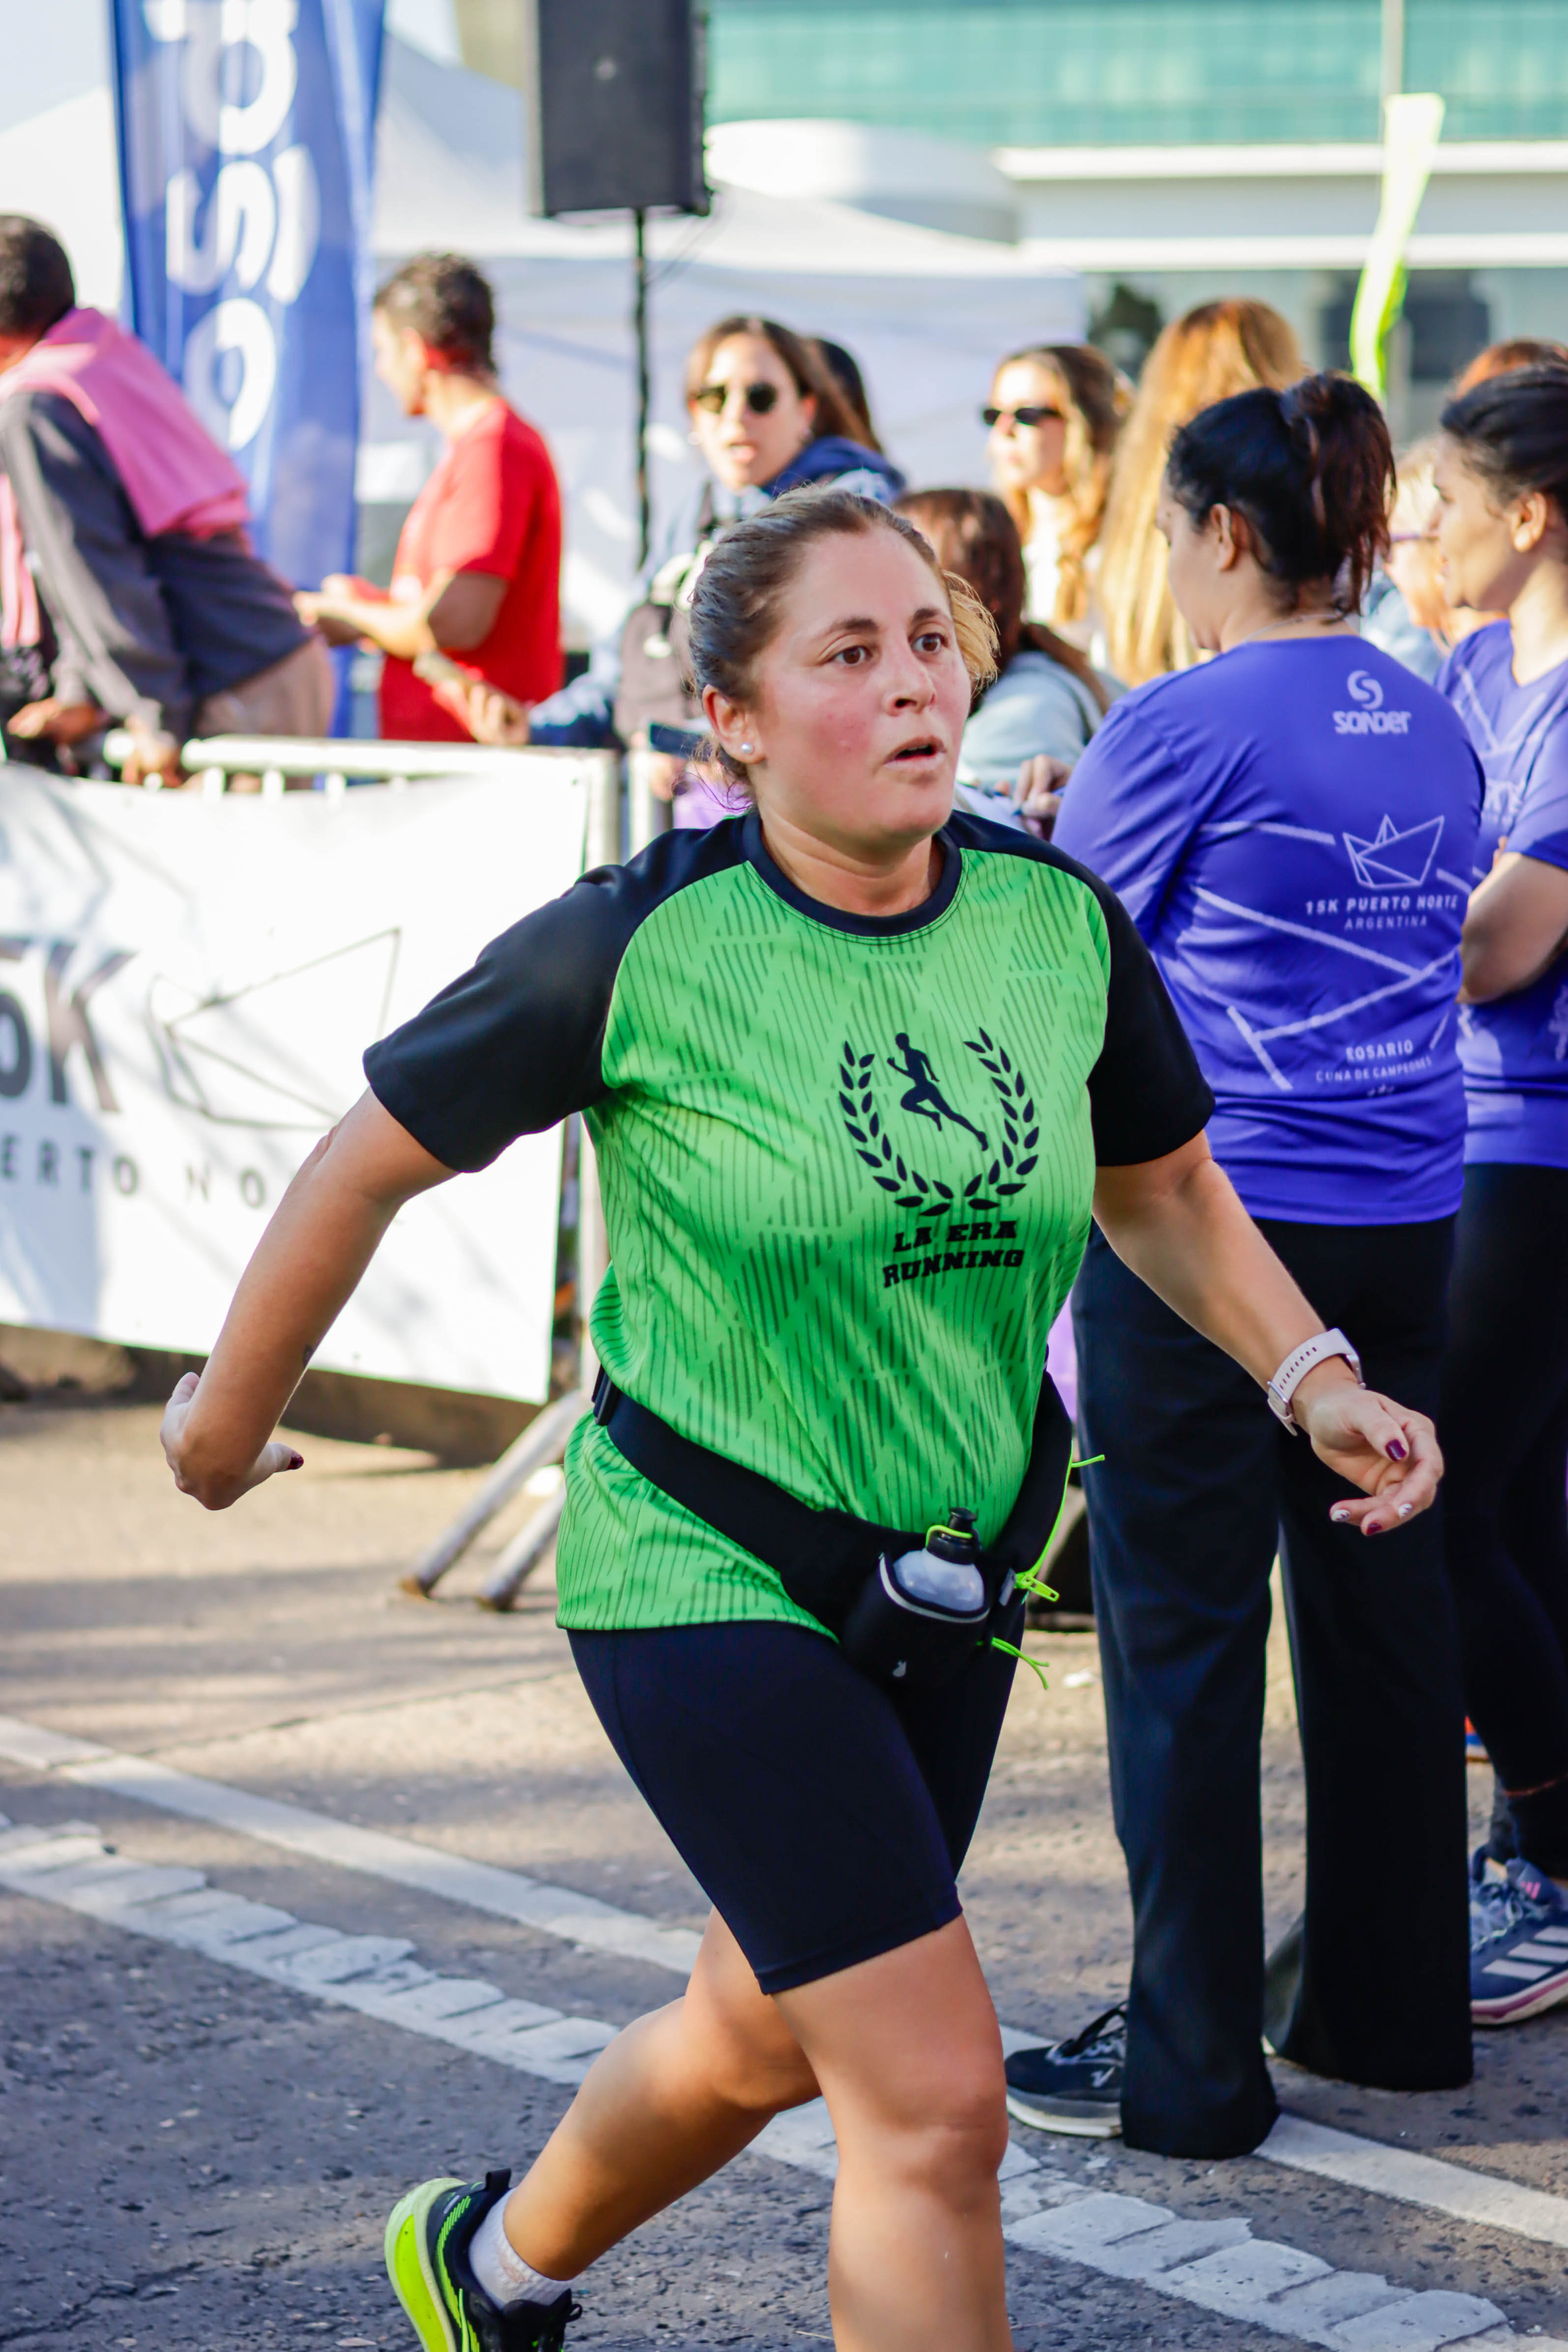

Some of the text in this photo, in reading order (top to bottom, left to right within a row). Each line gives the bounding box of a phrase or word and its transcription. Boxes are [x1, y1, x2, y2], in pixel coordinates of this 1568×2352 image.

[1306, 894, 1459, 915] 15K PUERTO NORTE
[1344, 915, 1427, 931] ARGENTINA
[1346, 1039, 1414, 1062] ROSARIO
[1316, 1055, 1432, 1082] CUNA DE CAMPEONES
[893, 1220, 1017, 1253] LA ERA
[883, 1249, 1024, 1288] RUNNING
